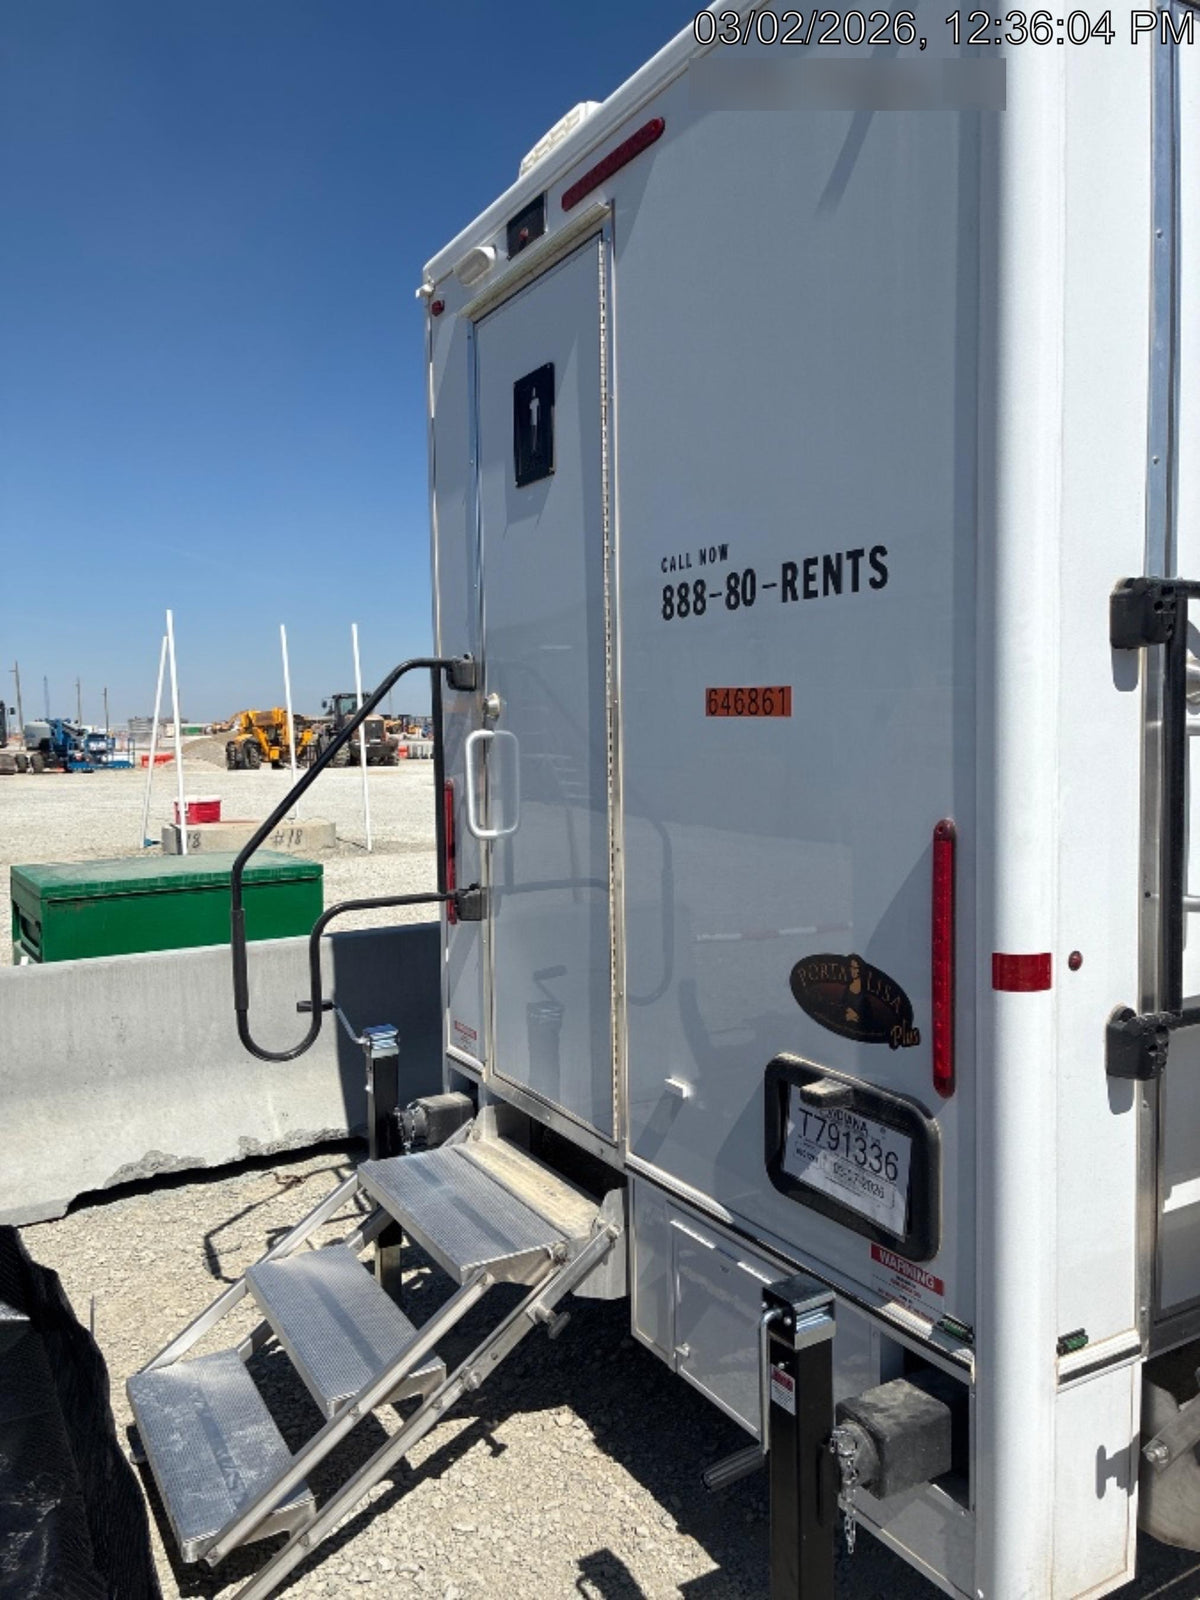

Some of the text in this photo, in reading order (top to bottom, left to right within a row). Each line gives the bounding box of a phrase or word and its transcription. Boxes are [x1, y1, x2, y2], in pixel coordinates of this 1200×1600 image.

[661, 544, 729, 573] CALL NOW
[662, 545, 889, 621] 888-80-RENTS
[707, 686, 787, 715] 646861
[798, 1107, 899, 1181] T791336
[880, 1249, 935, 1289] WARNING
